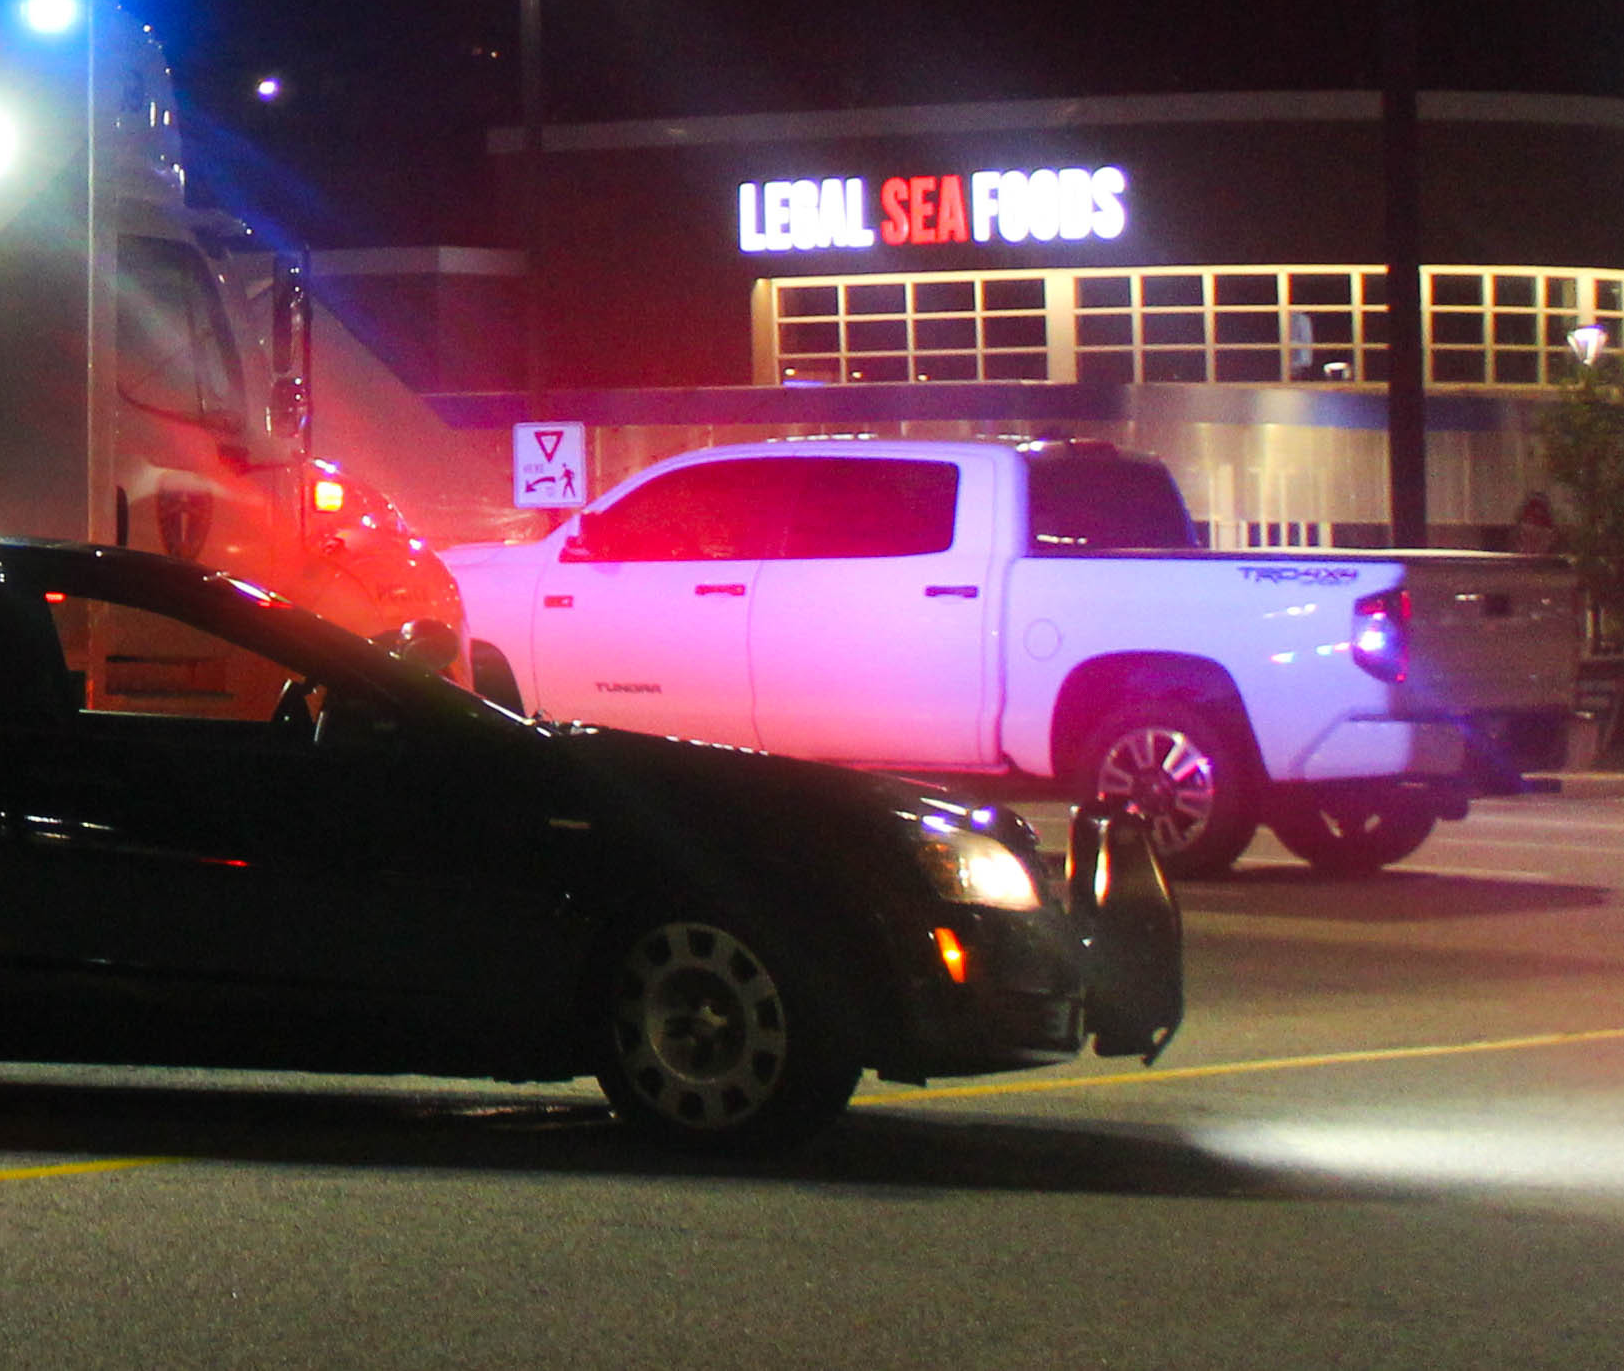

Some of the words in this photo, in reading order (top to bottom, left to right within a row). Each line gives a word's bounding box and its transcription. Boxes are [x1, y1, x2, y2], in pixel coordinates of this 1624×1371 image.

[739, 178, 874, 253] LEGAL
[880, 175, 970, 246] SEA
[971, 166, 1127, 243] FOODS
[595, 681, 662, 694] TUNDRA
